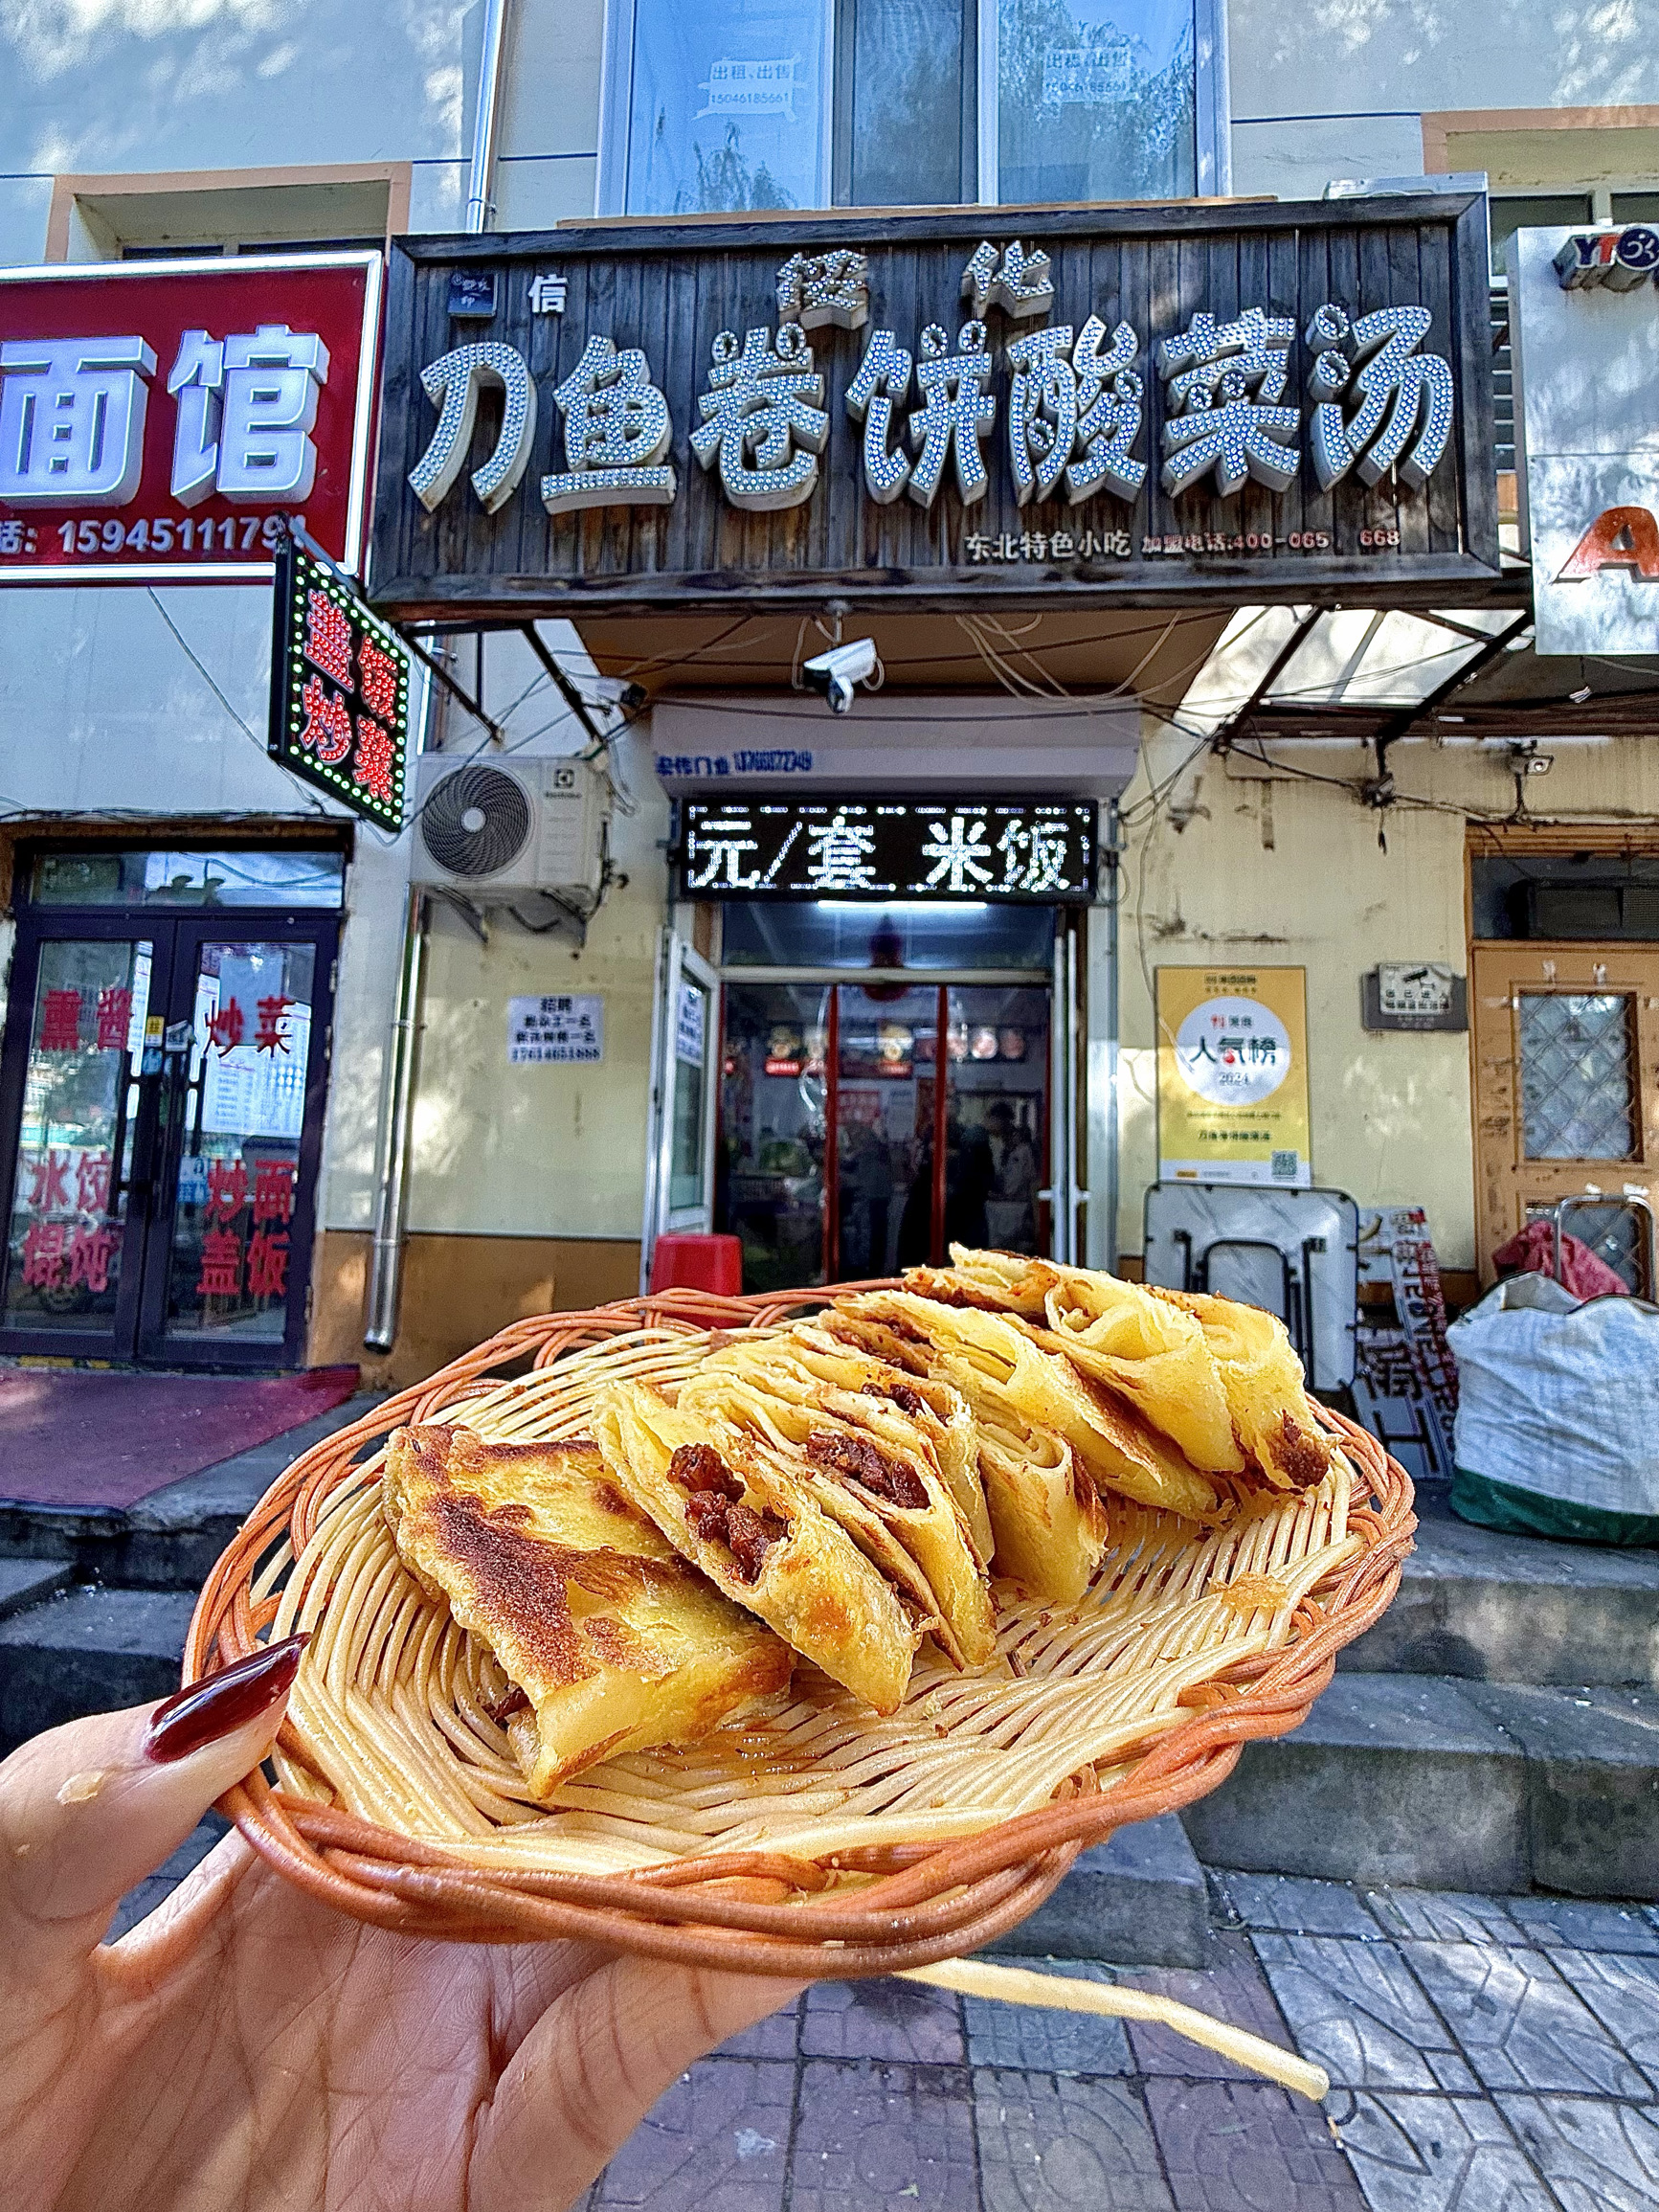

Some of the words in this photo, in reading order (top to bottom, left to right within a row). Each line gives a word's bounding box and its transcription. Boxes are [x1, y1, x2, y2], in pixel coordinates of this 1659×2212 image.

[527, 273, 569, 314] 信
[0, 323, 331, 508] 面馆
[408, 303, 1455, 517] 刀鱼卷饼酸菜汤
[964, 528, 1133, 561] 东北特色小吃
[299, 672, 398, 806] 炒菜
[202, 994, 296, 1059] 炒菜
[1189, 1034, 1277, 1066] 人气榜
[204, 1159, 296, 1225] 炒面
[195, 1228, 291, 1298] 盖饭
